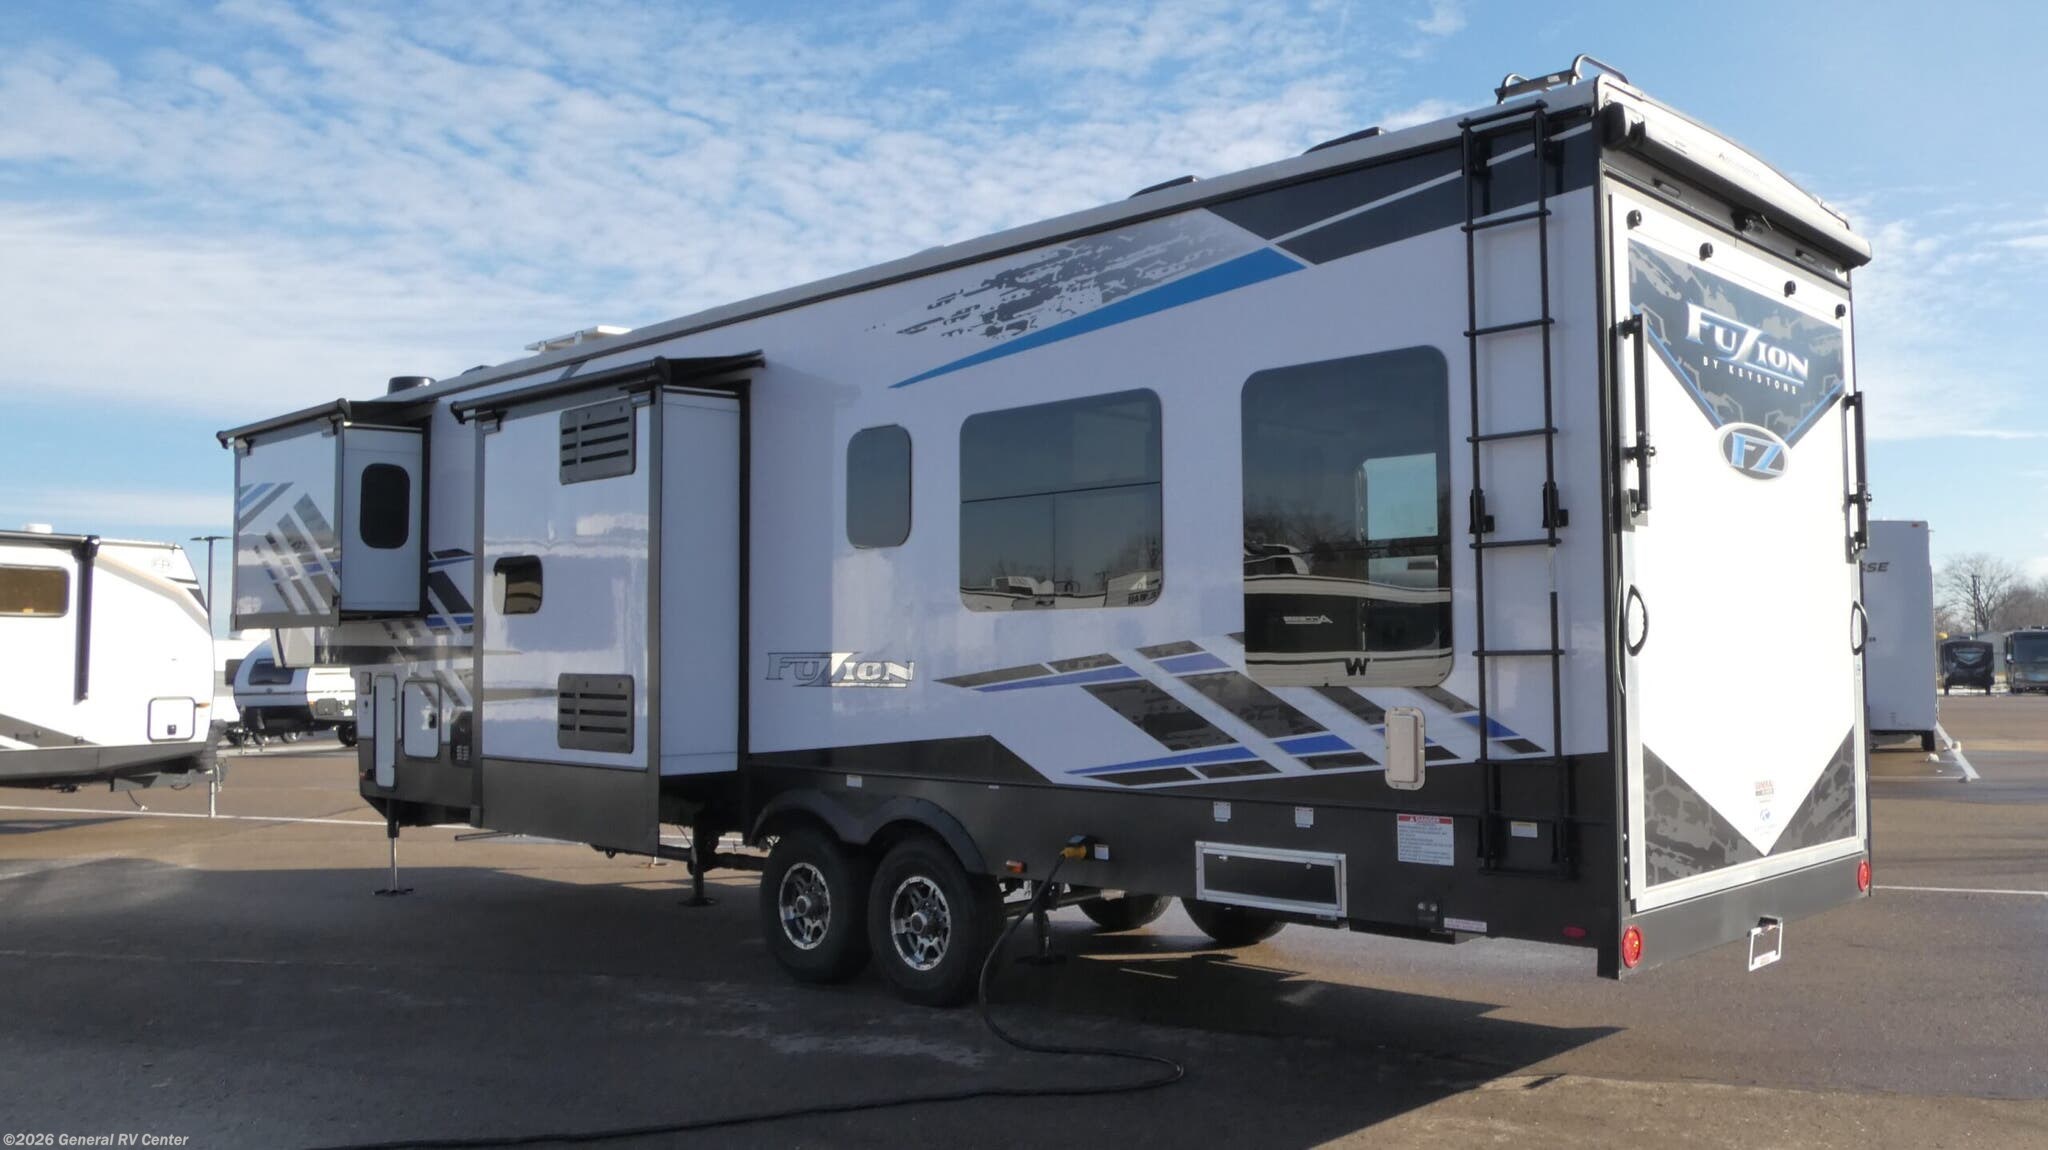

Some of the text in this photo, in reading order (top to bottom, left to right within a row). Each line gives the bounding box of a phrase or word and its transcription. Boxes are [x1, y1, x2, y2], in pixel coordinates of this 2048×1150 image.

[1703, 356, 1797, 395] BY KEYSTONE
[1731, 431, 1784, 476] FZ
